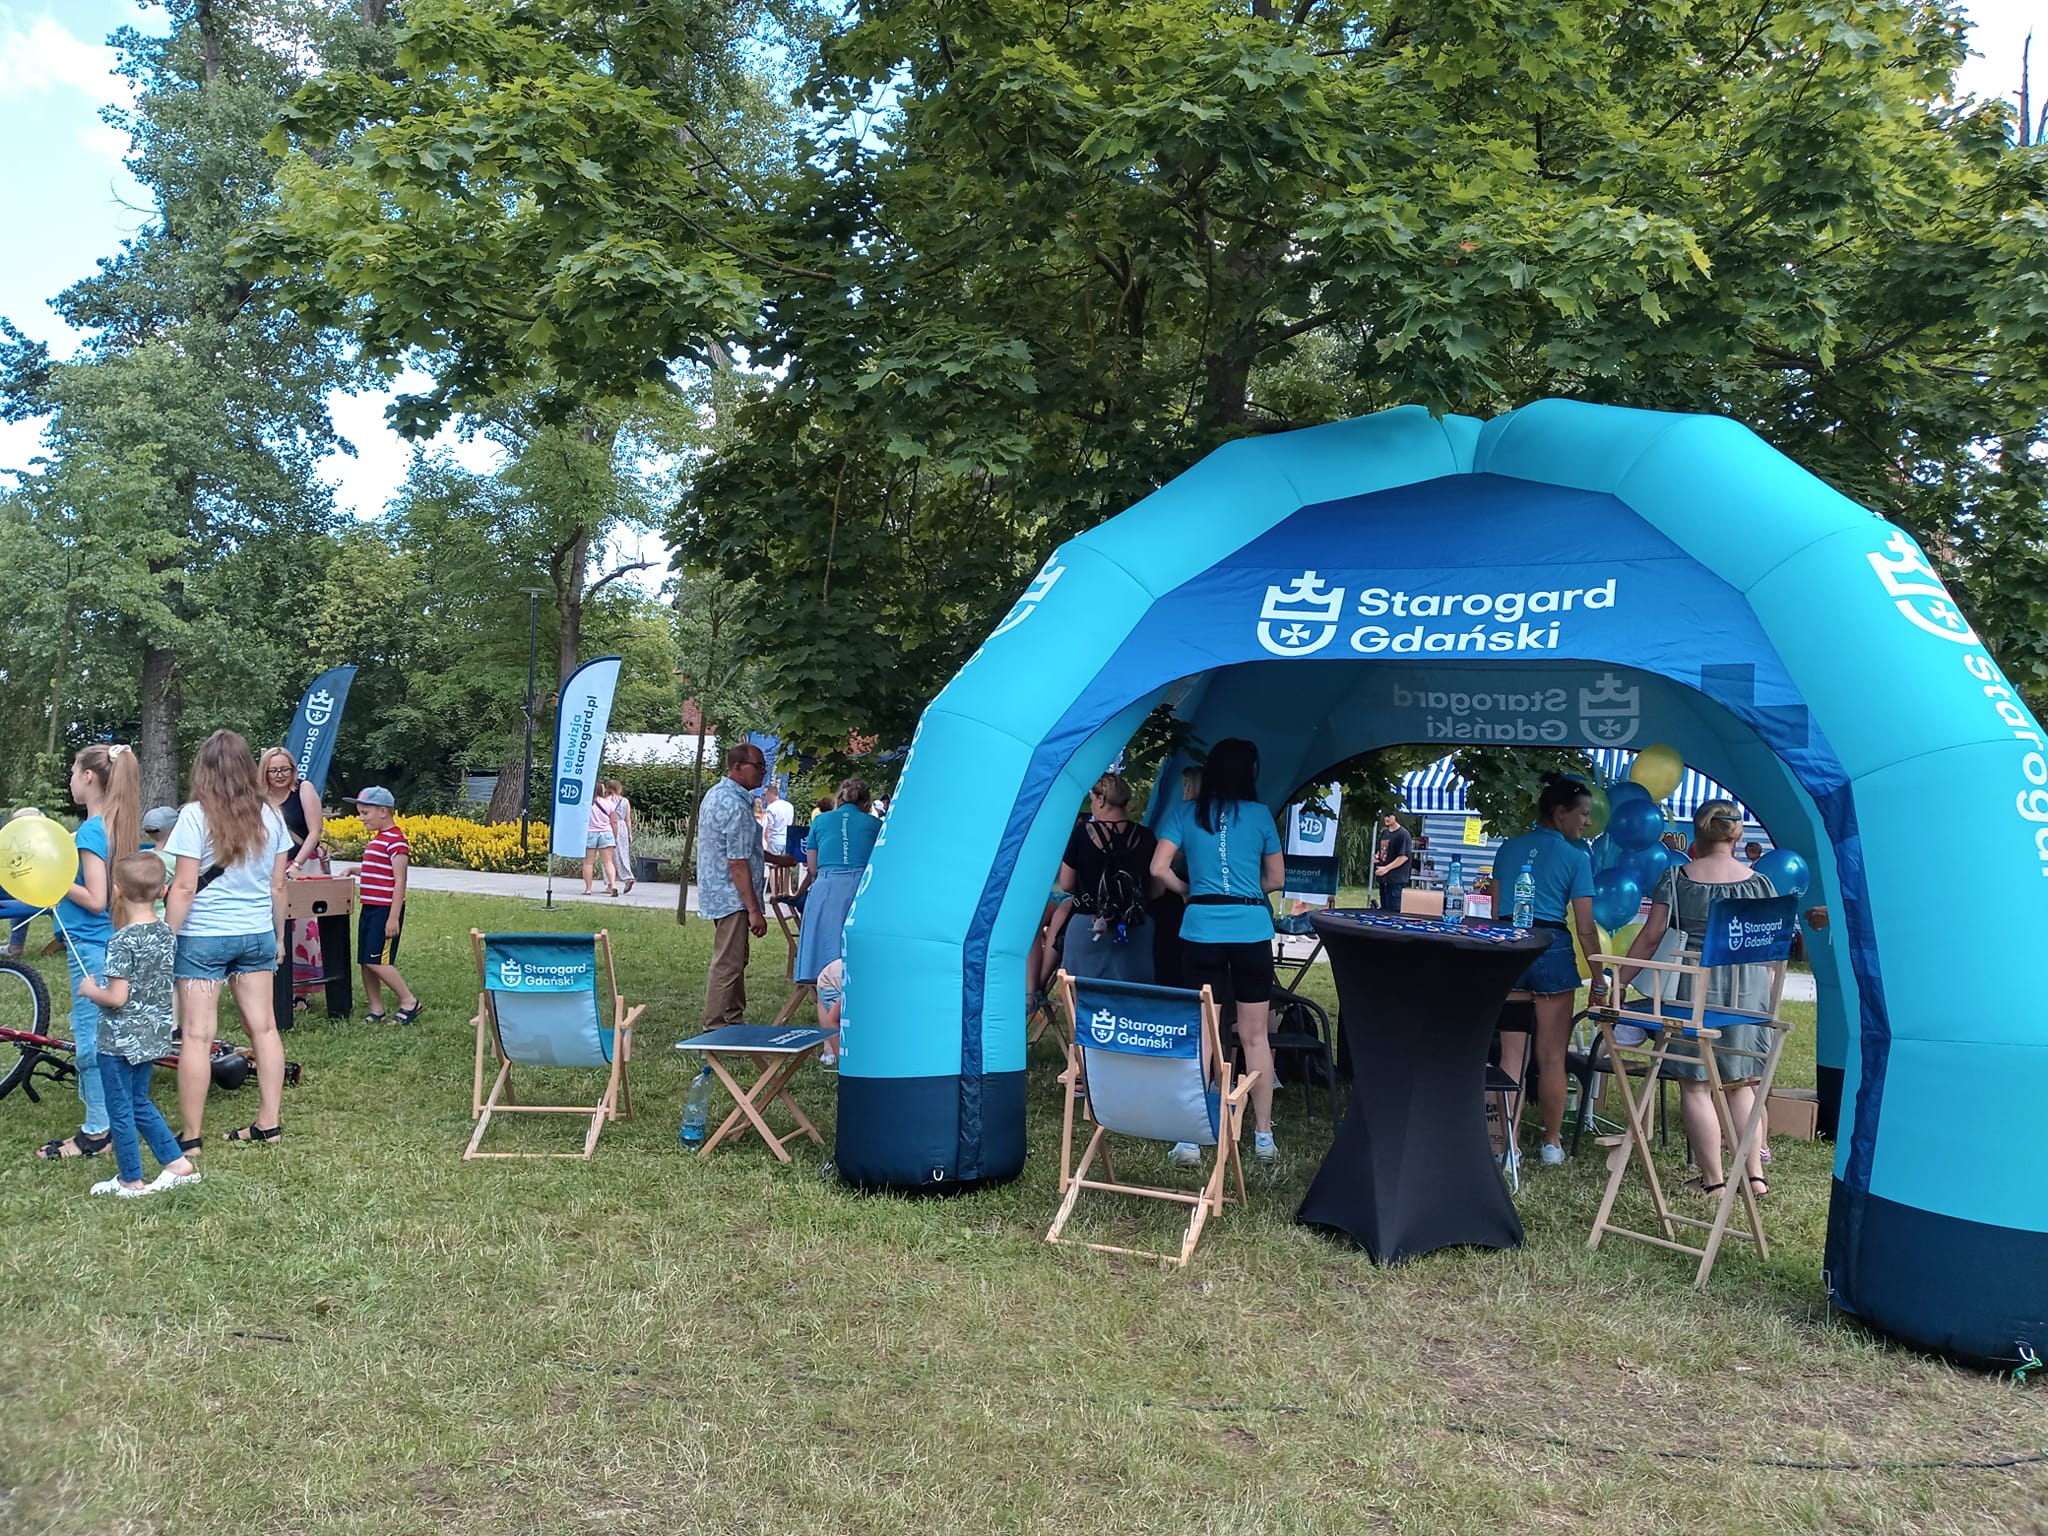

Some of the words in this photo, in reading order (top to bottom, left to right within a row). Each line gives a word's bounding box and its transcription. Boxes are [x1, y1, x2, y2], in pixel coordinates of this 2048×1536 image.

[1357, 578, 1617, 623] Starogard
[1350, 621, 1561, 654] Gdański
[562, 714, 582, 774] telewizja
[574, 695, 598, 775] starogard.pl
[297, 727, 320, 780] Staroga
[1963, 653, 2048, 877] Staroga
[1744, 918, 1783, 935] Starogard
[1744, 934, 1776, 948] Gdański
[524, 963, 586, 976] Starogard
[524, 975, 574, 986] Gdański
[1118, 1017, 1188, 1037] Starogard
[1117, 1032, 1173, 1049] Gdański
